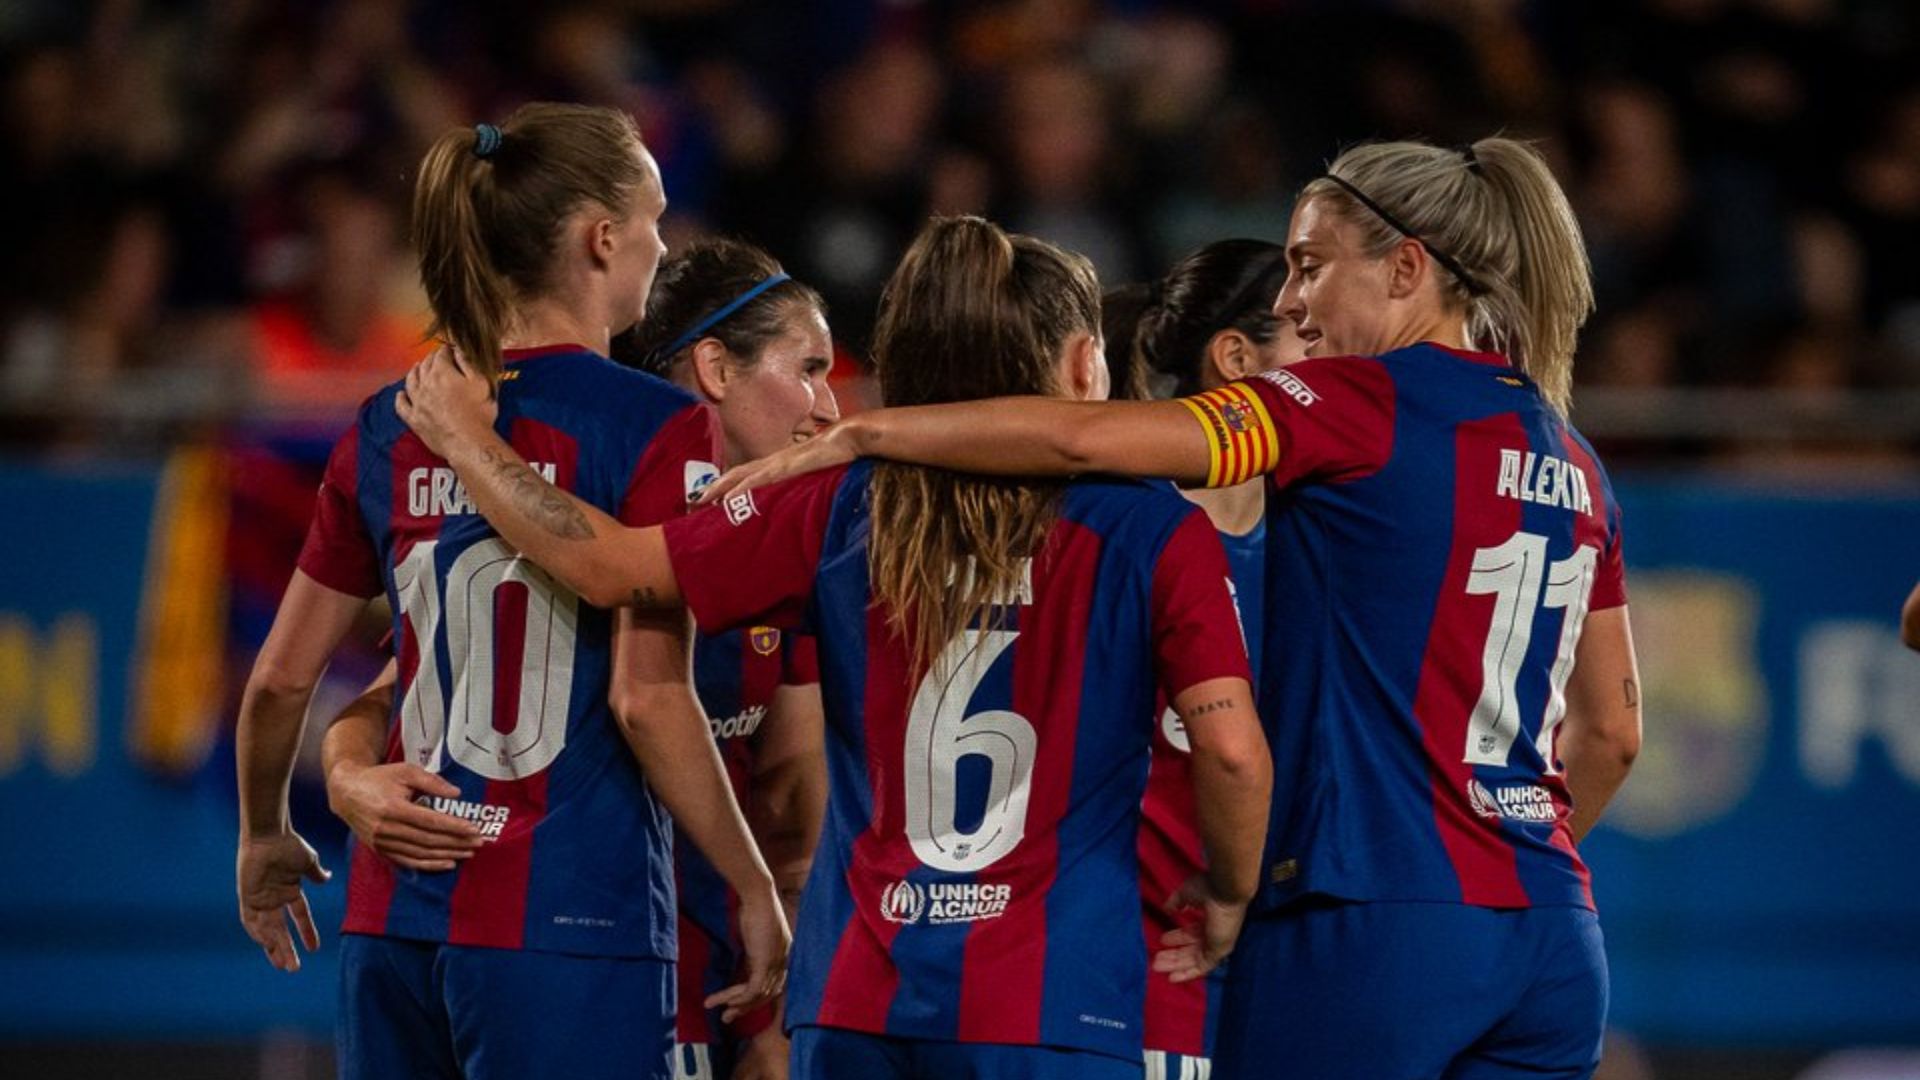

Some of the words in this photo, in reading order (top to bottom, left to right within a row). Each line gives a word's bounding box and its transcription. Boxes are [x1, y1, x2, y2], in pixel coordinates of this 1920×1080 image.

[1497, 448, 1593, 517] ALEXIA
[394, 537, 579, 782] 10
[1462, 531, 1600, 777] 11
[904, 629, 1038, 873] 6
[433, 796, 511, 823] UNHCR
[1496, 785, 1553, 804] UNHCR
[928, 884, 1012, 901] UNHCR
[928, 899, 1009, 918] ACNUR
